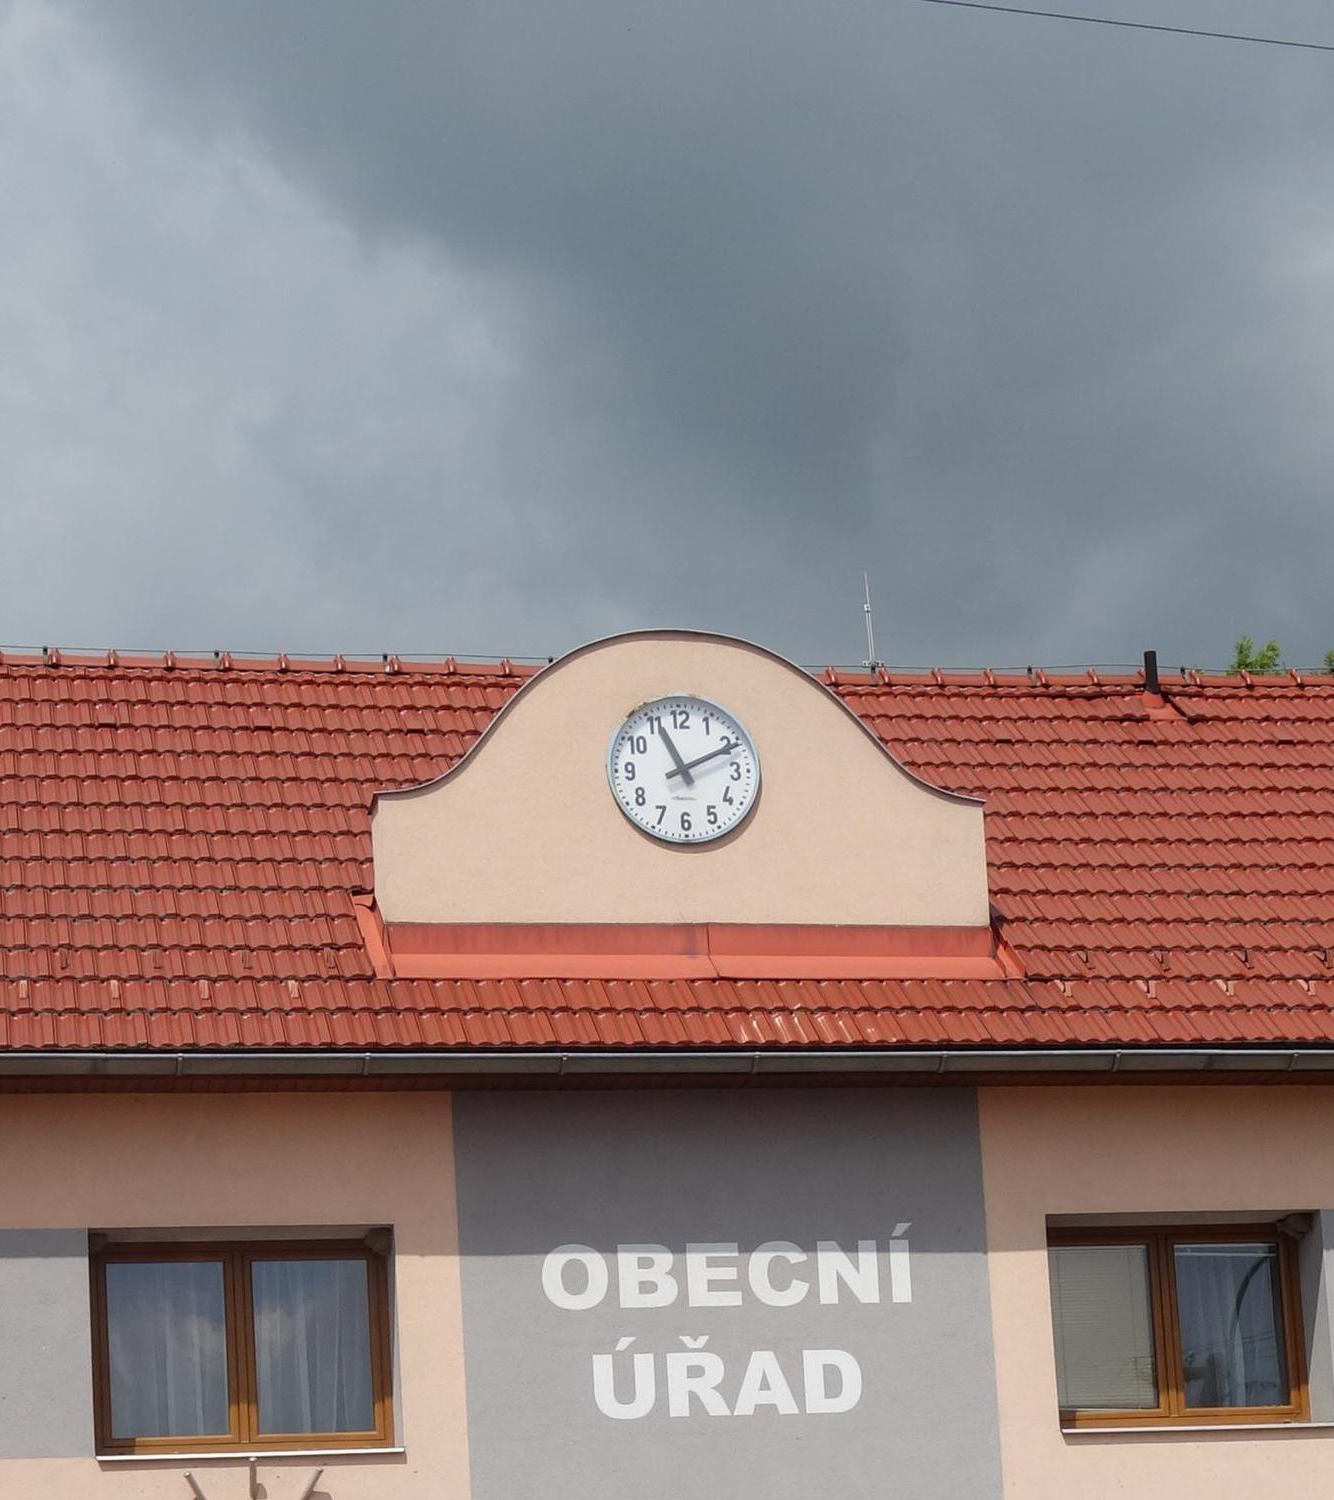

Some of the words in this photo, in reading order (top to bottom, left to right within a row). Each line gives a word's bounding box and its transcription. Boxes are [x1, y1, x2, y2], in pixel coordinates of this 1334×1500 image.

[647, 716, 662, 735] 11
[670, 710, 690, 729] 12
[702, 717, 710, 735] 1
[628, 735, 647, 754] 10
[720, 736, 732, 754] 2
[624, 762, 635, 780] 9
[730, 762, 741, 780] 3
[635, 787, 645, 806] 8
[723, 786, 734, 805] 4
[655, 805, 667, 825] 7
[681, 812, 692, 831] 6
[706, 806, 718, 824] 5
[542, 1222, 912, 1310] OBECNÍ
[592, 1335, 862, 1419] ÚŘAD
